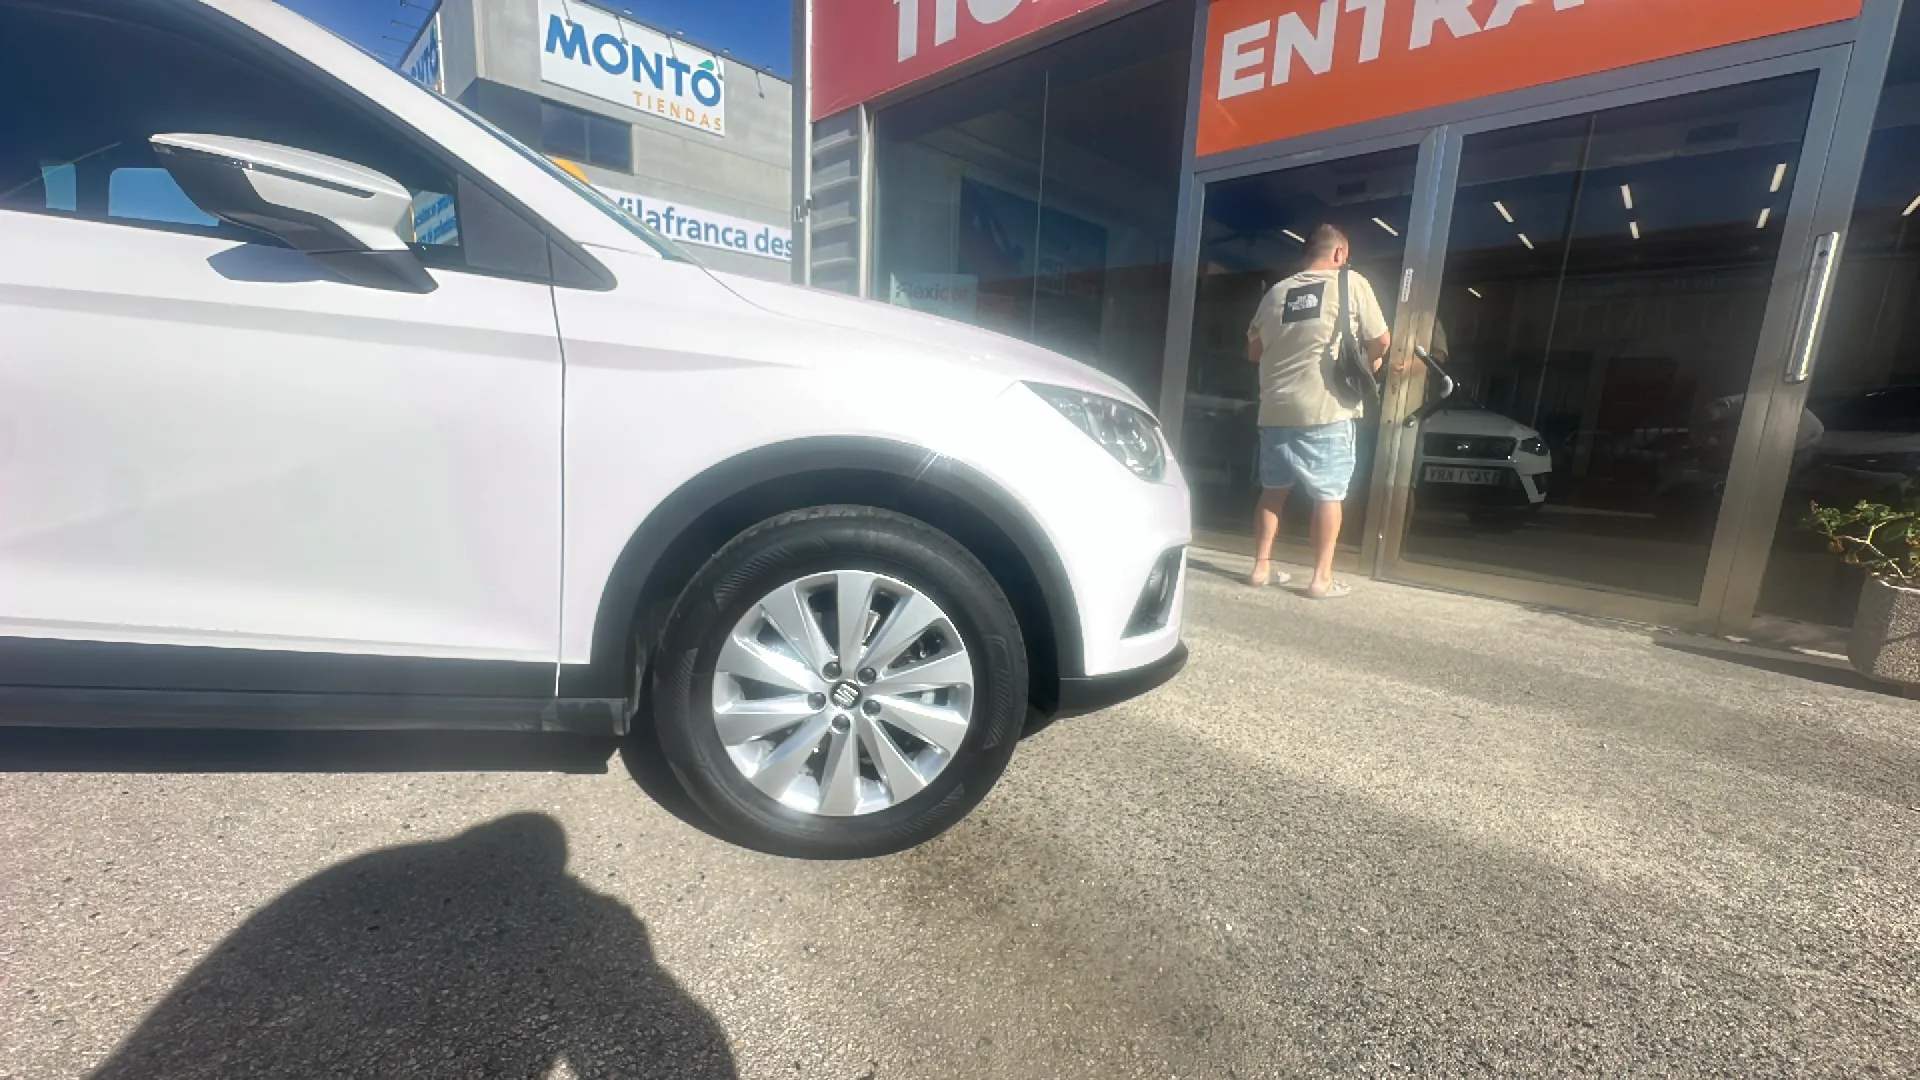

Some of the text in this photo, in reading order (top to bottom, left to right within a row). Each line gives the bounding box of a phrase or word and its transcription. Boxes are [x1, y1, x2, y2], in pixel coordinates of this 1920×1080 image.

[1218, 0, 1585, 100] ENTR
[632, 90, 722, 131] TIENDAS
[618, 197, 748, 250] ilafranca
